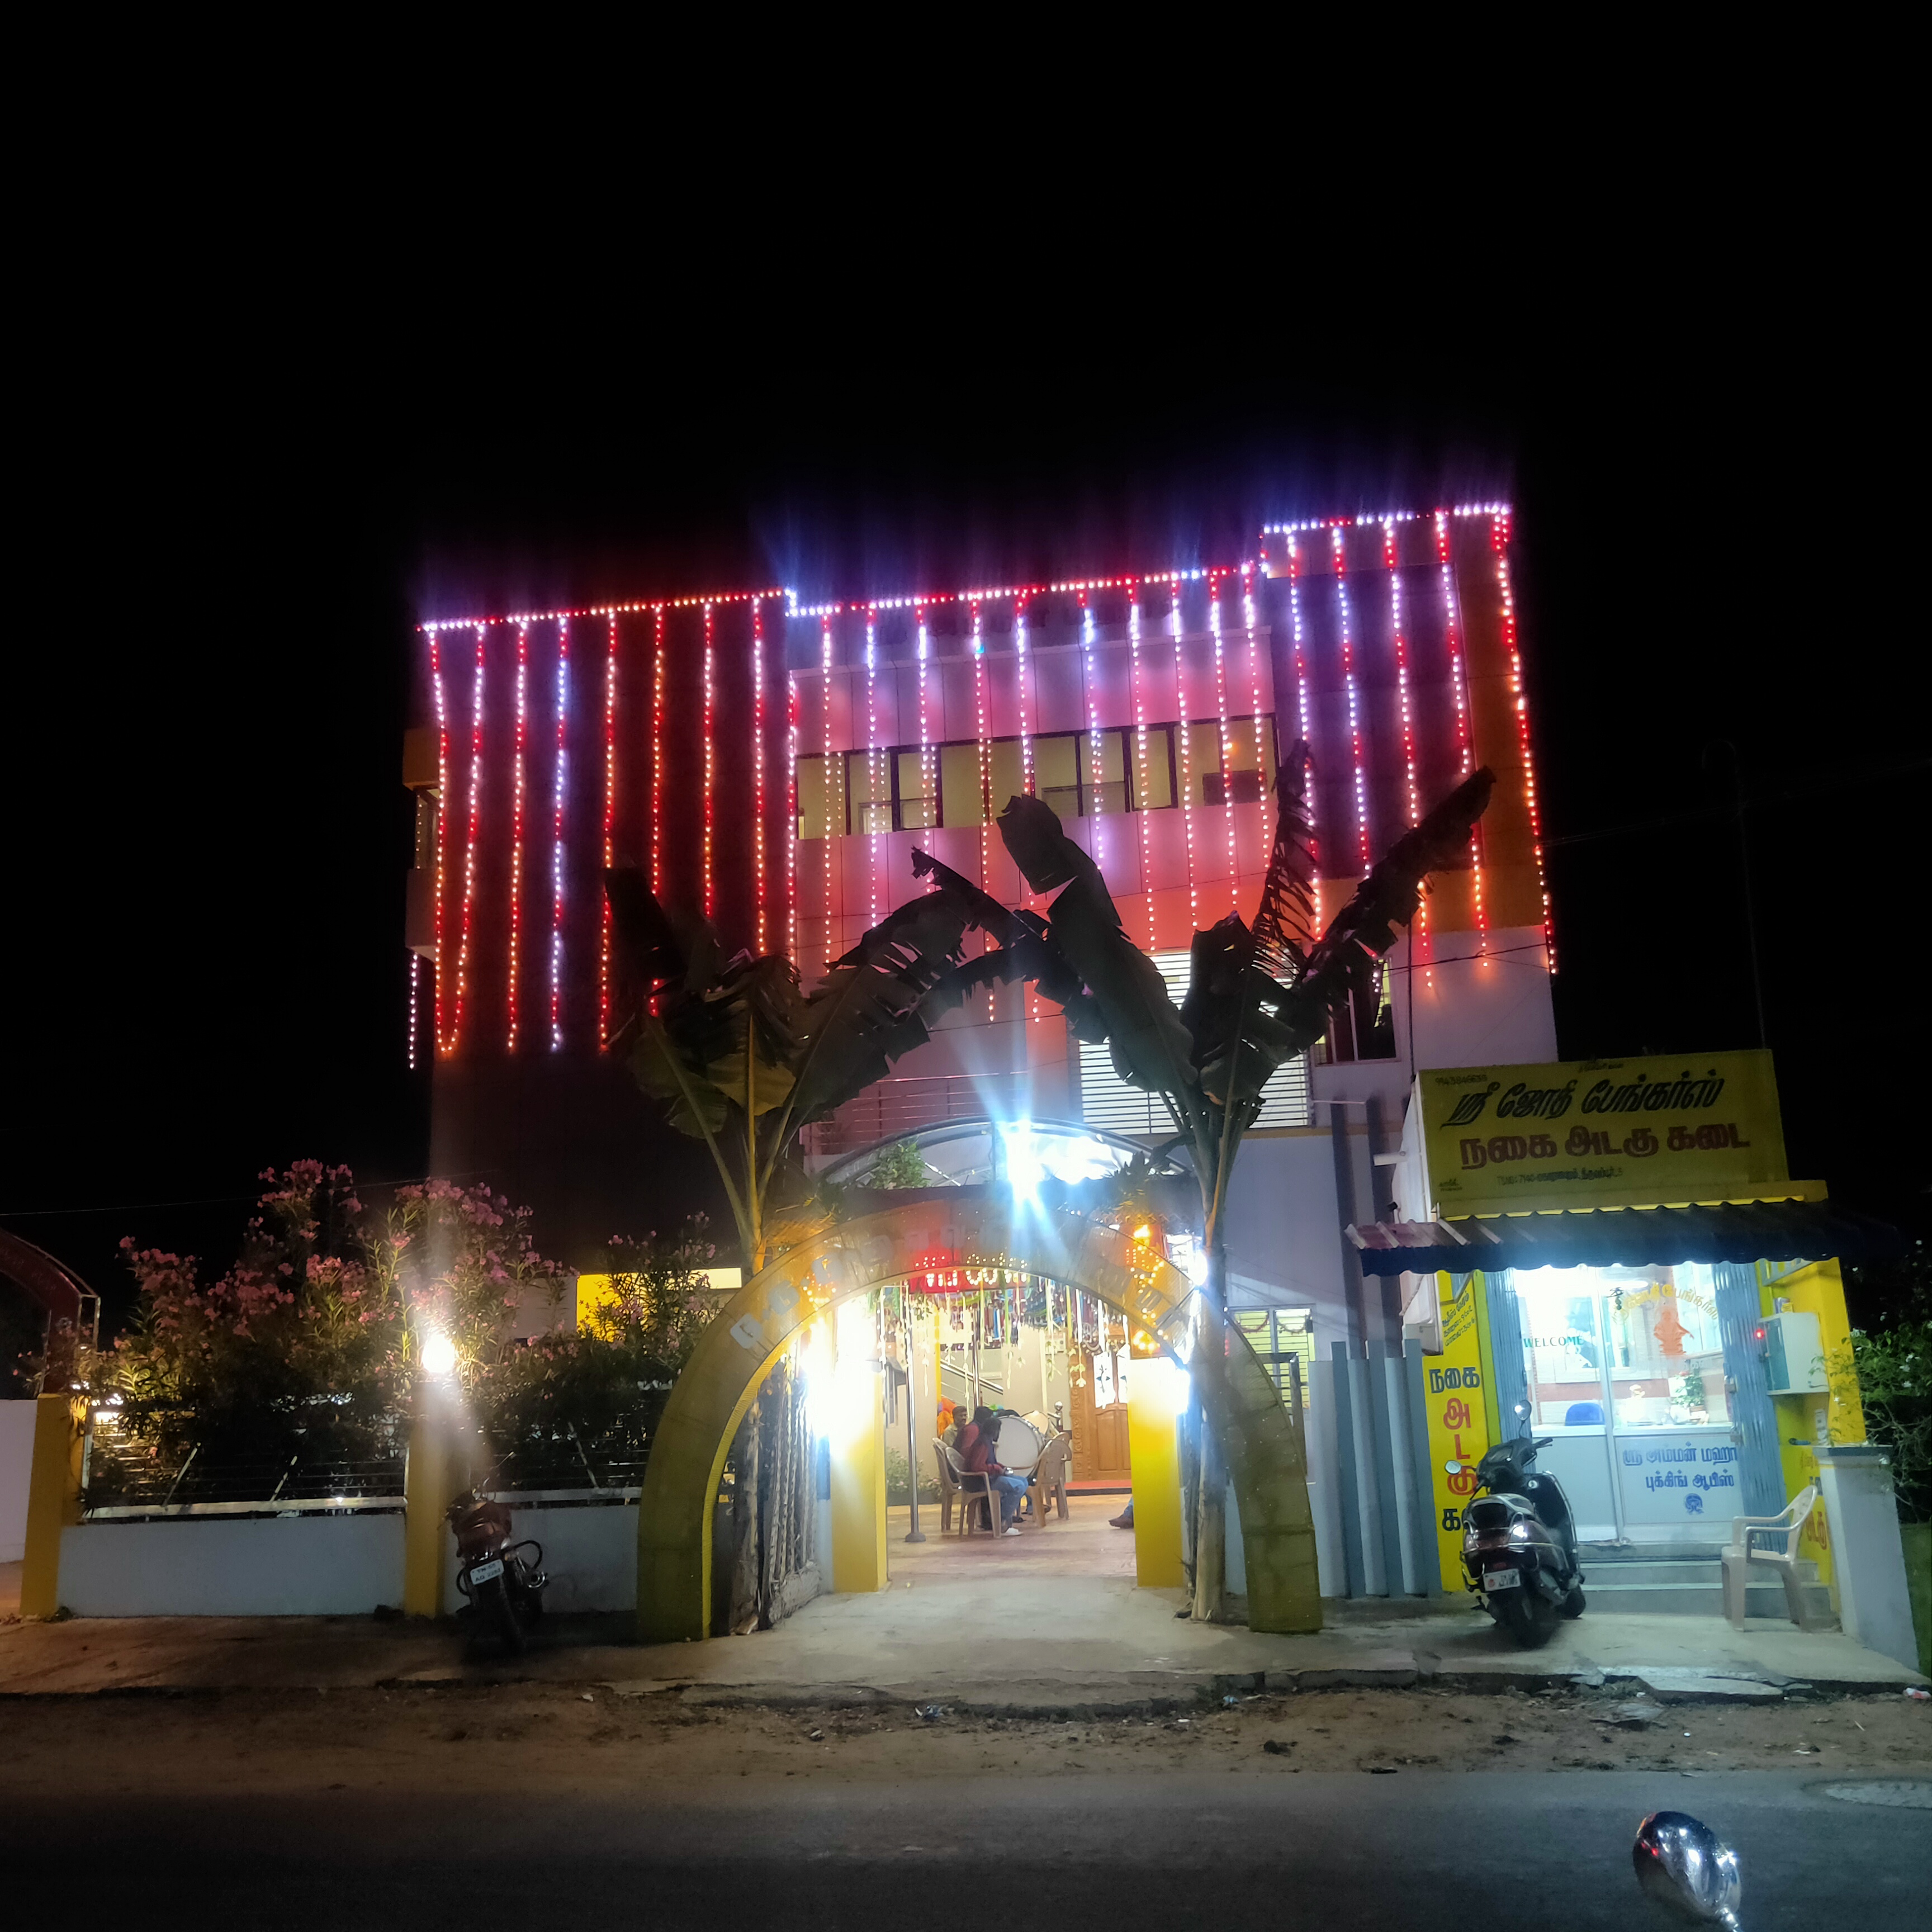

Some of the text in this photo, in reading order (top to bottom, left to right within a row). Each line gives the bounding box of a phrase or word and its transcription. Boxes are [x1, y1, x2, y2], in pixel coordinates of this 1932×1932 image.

[1497, 1079, 1578, 1120] ஜோதி
[1581, 1069, 1725, 1114] பேங்கர்ஸ்
[1460, 1123, 1750, 1169] நகை அடகு கடை
[1523, 1336, 1584, 1347] WELCOME
[1429, 1367, 1480, 1393] நகை
[1646, 1469, 1688, 1492] புக்கிங்
